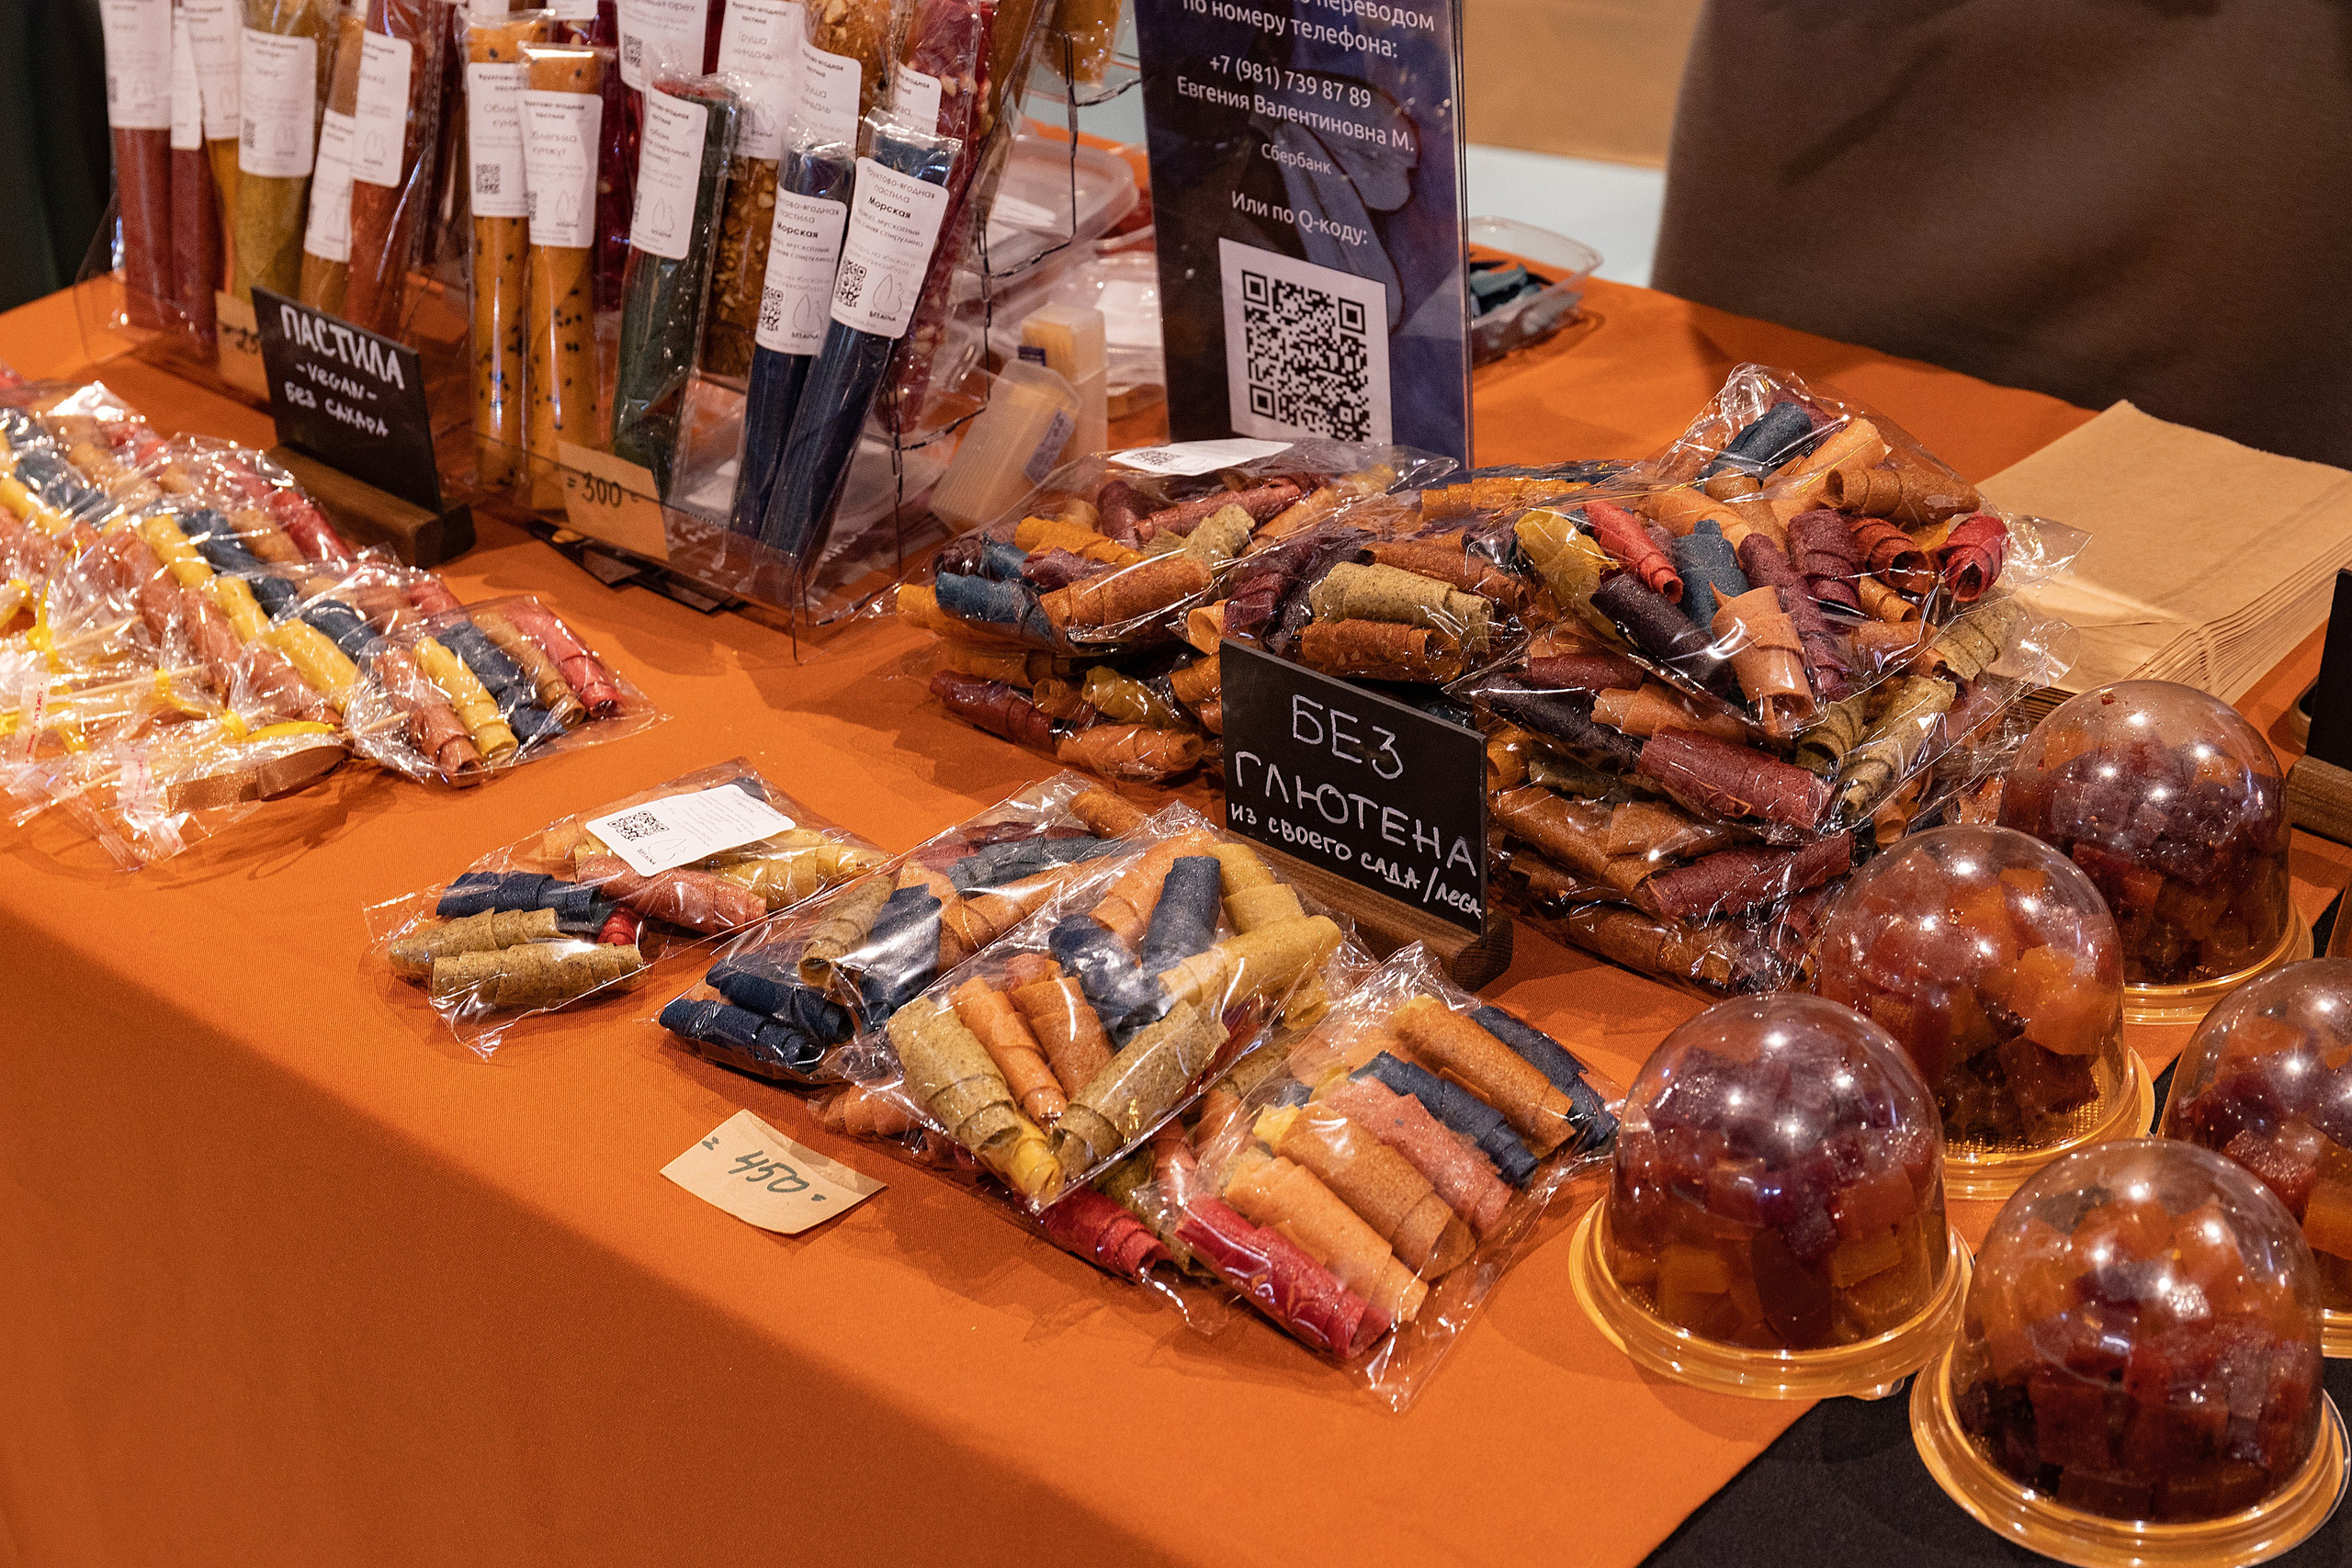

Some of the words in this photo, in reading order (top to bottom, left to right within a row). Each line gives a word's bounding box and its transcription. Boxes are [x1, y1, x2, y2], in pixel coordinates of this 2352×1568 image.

[739, 31, 768, 45] Груша
[1212, 1, 1285, 36] номеру
[1290, 18, 1397, 58] телефона:
[1209, 55, 1230, 73] +7
[1235, 57, 1281, 90] (981)
[1284, 70, 1317, 96] 739
[1322, 79, 1344, 102] 87
[1349, 86, 1371, 108] 89
[1177, 75, 1250, 110] Евгения
[1253, 94, 1387, 145] Валентиновна
[1392, 129, 1415, 152] М.
[1261, 143, 1332, 175] Сбербанк
[867, 196, 911, 220] Морская
[874, 184, 910, 204] пастила
[776, 220, 819, 239] Морская
[879, 228, 924, 247] спирулина
[1231, 190, 1268, 219] Или
[1272, 205, 1295, 224] по
[1298, 209, 1368, 246] Q-коду:
[279, 304, 405, 390] ПАСТИЛА
[324, 398, 389, 437] САХАРА
[1292, 694, 1404, 780] БЕЗ
[1235, 751, 1477, 877] ГЛЮТЕНА
